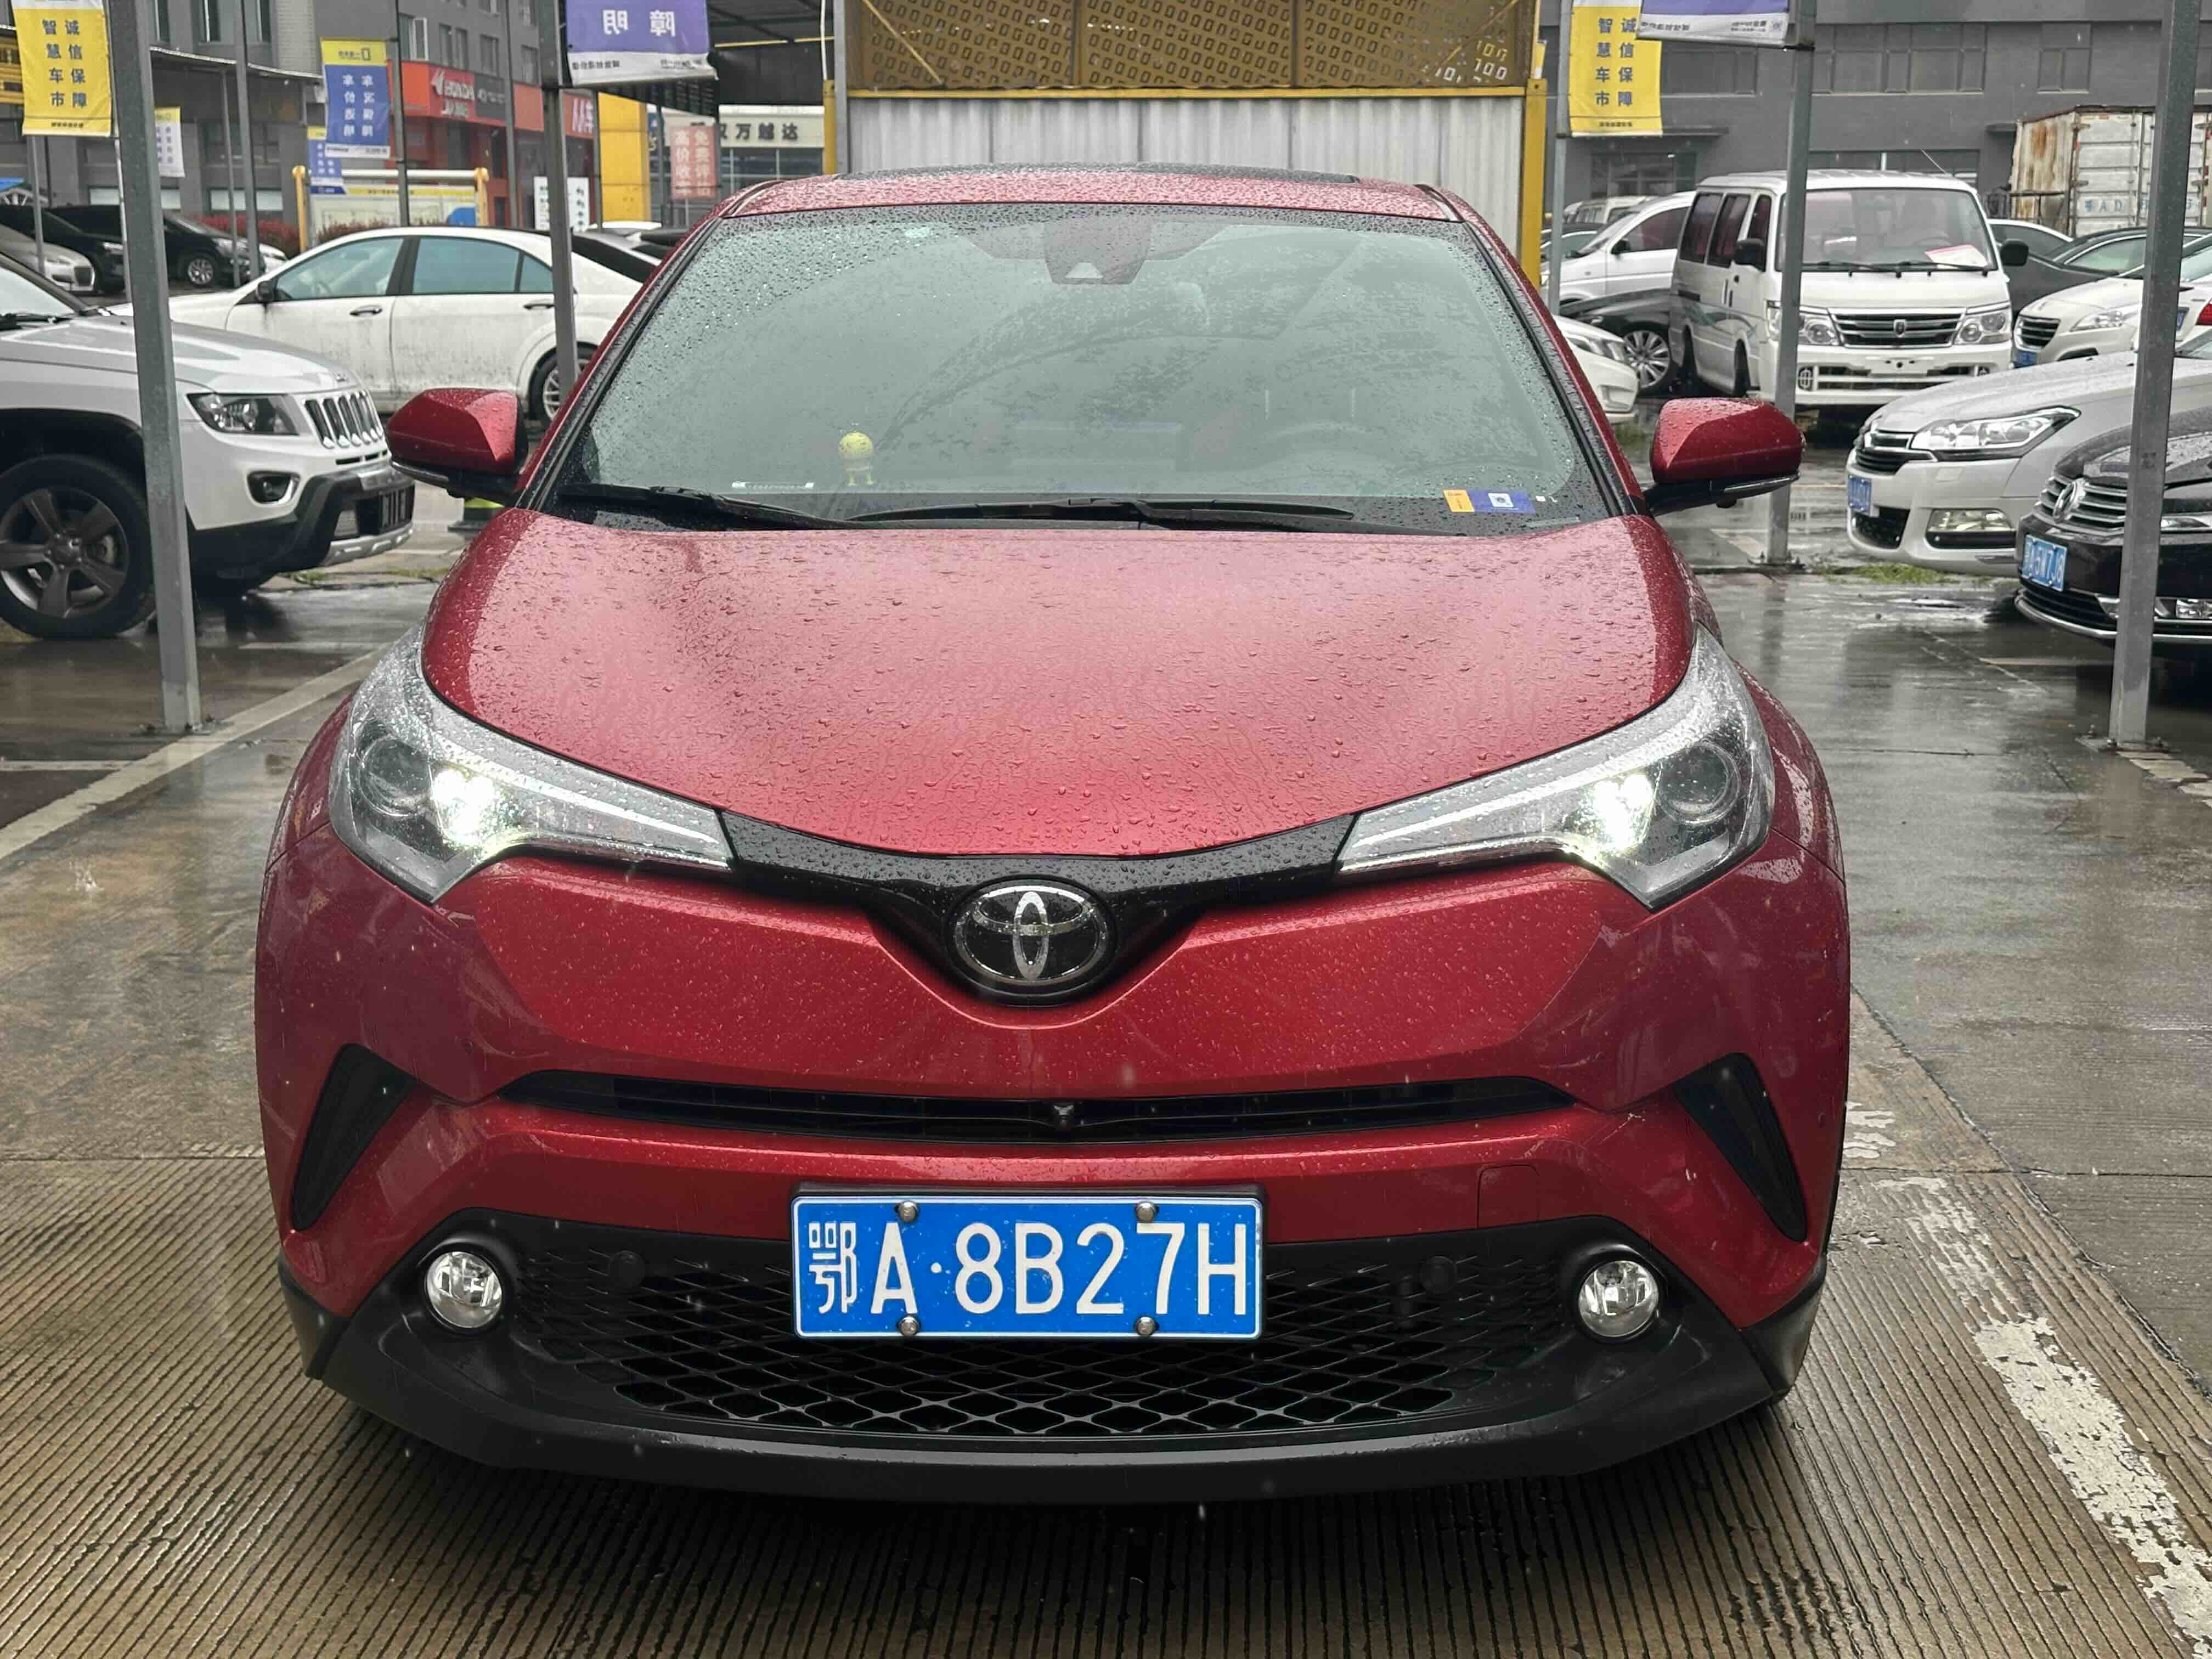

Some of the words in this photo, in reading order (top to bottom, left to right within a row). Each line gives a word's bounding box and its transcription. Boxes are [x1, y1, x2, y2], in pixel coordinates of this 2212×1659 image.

[42, 19, 65, 107] 智慧车市
[65, 19, 87, 108] 诚信保障
[1595, 17, 1613, 106] 智慧车市
[1617, 17, 1637, 107] 诚信保障
